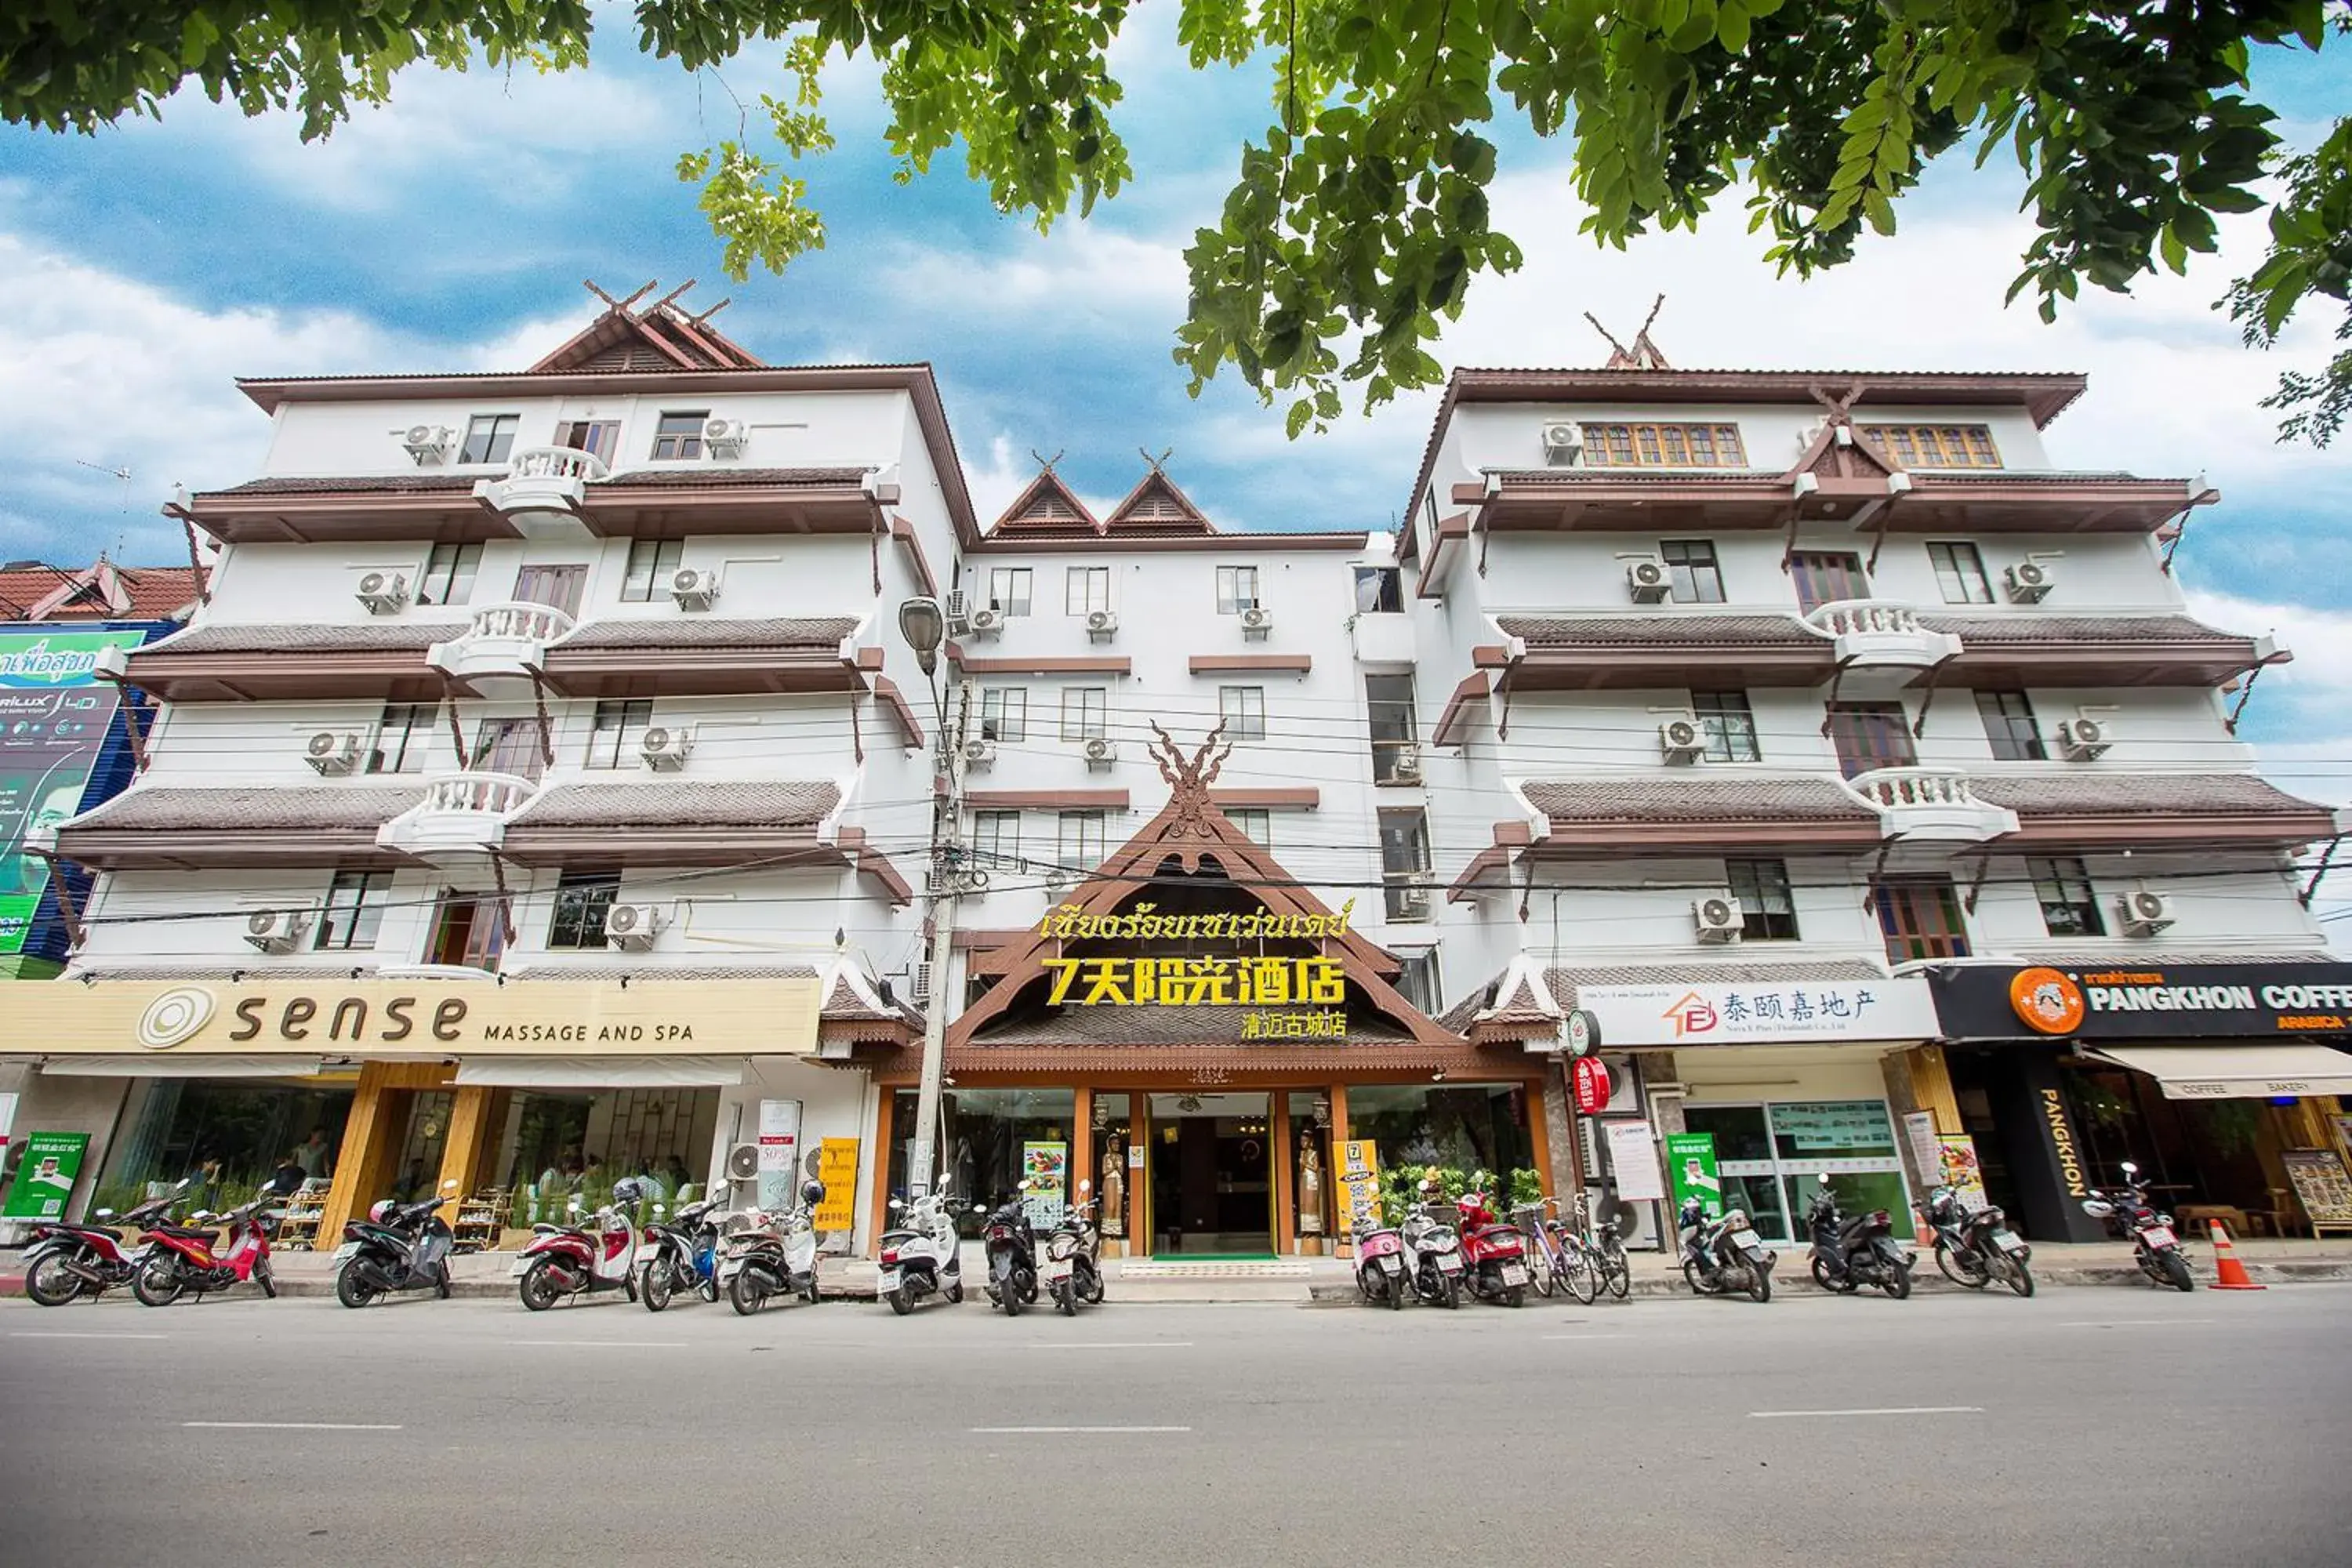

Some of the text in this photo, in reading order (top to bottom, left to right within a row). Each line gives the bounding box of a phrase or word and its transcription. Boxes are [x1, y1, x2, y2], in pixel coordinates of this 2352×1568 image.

[1723, 989, 1875, 1022] 泰颐嘉地产
[2087, 985, 2256, 1011] PANGKHON
[229, 997, 694, 1041] sense MASSAGE AND SPA
[1241, 1011, 1347, 1040] 清迈古城店
[2183, 1082, 2309, 1094] COFFEE BAKERY
[2041, 1089, 2088, 1197] PANGKHON
